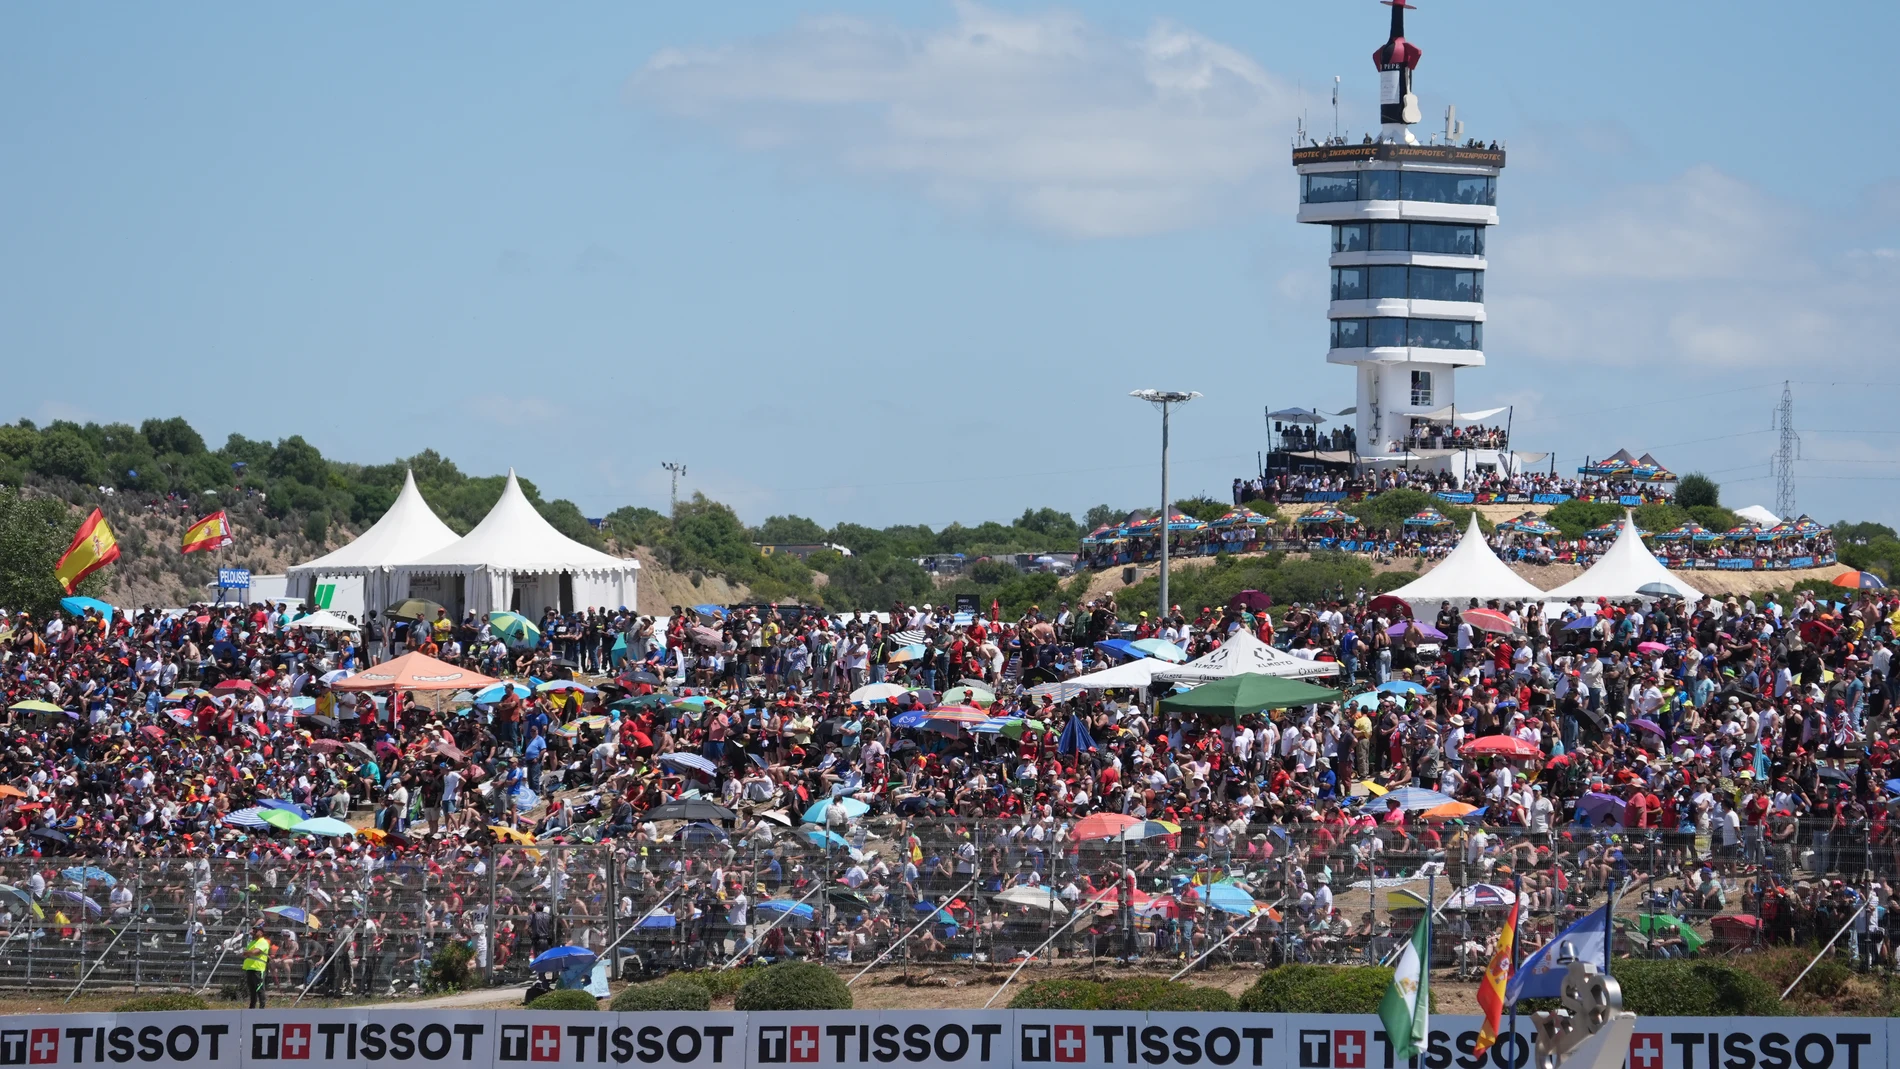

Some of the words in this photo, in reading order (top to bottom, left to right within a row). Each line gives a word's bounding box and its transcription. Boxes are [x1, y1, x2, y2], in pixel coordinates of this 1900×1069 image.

[220, 570, 249, 584] PELOUSSE
[1194, 662, 1223, 670] XLMOTO
[1256, 660, 1293, 668] XLMOTO
[66, 1025, 229, 1063] TISSOT
[318, 1024, 484, 1060] TISSOT
[567, 1026, 734, 1063] TISSOT
[826, 1024, 1002, 1062] TISSOT
[1093, 1026, 1274, 1065] TISSOT
[1671, 1032, 1872, 1069] TISSOT
